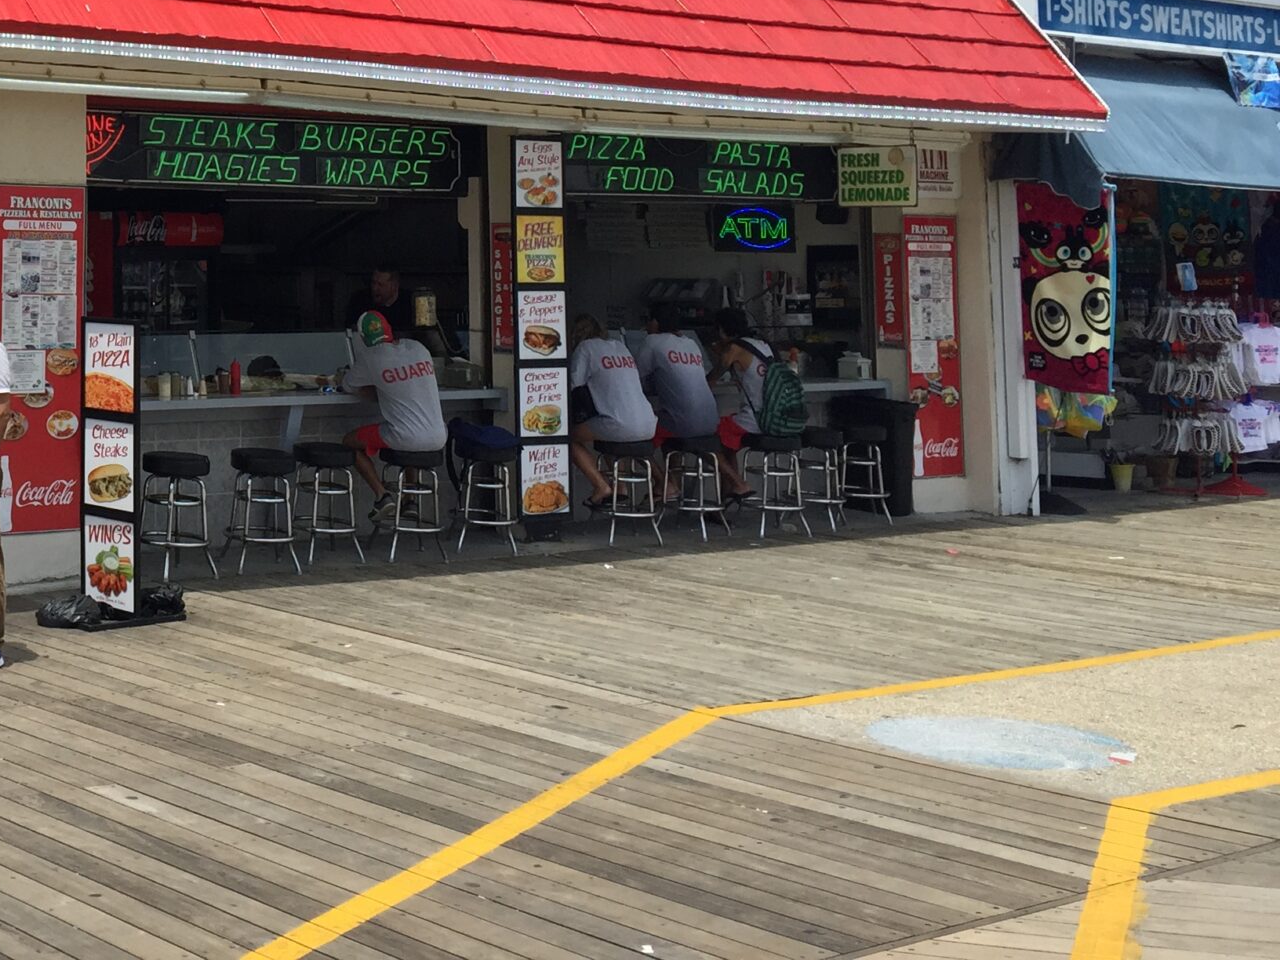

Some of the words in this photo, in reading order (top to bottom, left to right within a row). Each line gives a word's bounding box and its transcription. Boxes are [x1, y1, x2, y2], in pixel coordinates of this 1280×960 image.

[143, 117, 279, 150] STEAKS
[300, 124, 451, 156] BURGERS
[532, 143, 553, 154] Eggs
[568, 134, 646, 161] PIZZA
[713, 141, 791, 168] PASTA
[518, 156, 534, 167] Any
[537, 154, 560, 166] Style
[840, 153, 880, 168] FRESH
[919, 149, 949, 170] ATM
[154, 152, 300, 184] HOAGIES
[325, 158, 432, 186] WRAPS
[605, 167, 675, 192] FOOD
[702, 170, 806, 197] SALADS
[841, 170, 904, 186] SQUEEZED
[10, 196, 72, 209] FRANCONI'S
[841, 187, 910, 202] LEMONADE
[0, 209, 31, 218] PIZZERIA
[32, 210, 38, 218] &
[39, 210, 82, 219] RESTAURANT
[18, 220, 37, 230] FULL
[38, 221, 62, 230] MENU
[524, 221, 556, 237] FREE
[720, 217, 788, 241] ATM
[517, 234, 563, 253] DELIVERY!
[526, 259, 556, 268] PIZZA
[494, 249, 503, 326] SAUSAGE
[883, 254, 897, 324] PIZZAS
[529, 304, 563, 318] Peppers
[107, 331, 132, 348] Plain
[91, 349, 131, 369] PIZZA
[601, 355, 635, 370] GUAR
[667, 350, 703, 367] GUAR
[382, 361, 434, 384] GUARD
[524, 371, 560, 383] Cheese
[527, 382, 558, 394] Burger
[527, 395, 535, 404] &
[538, 393, 562, 403] Fries
[92, 424, 129, 440] Cheese
[93, 442, 128, 459] Steaks
[528, 447, 561, 463] Waffle
[533, 461, 558, 475] Fries
[15, 479, 77, 507] Coca-Cola
[87, 524, 132, 545] WINGS
